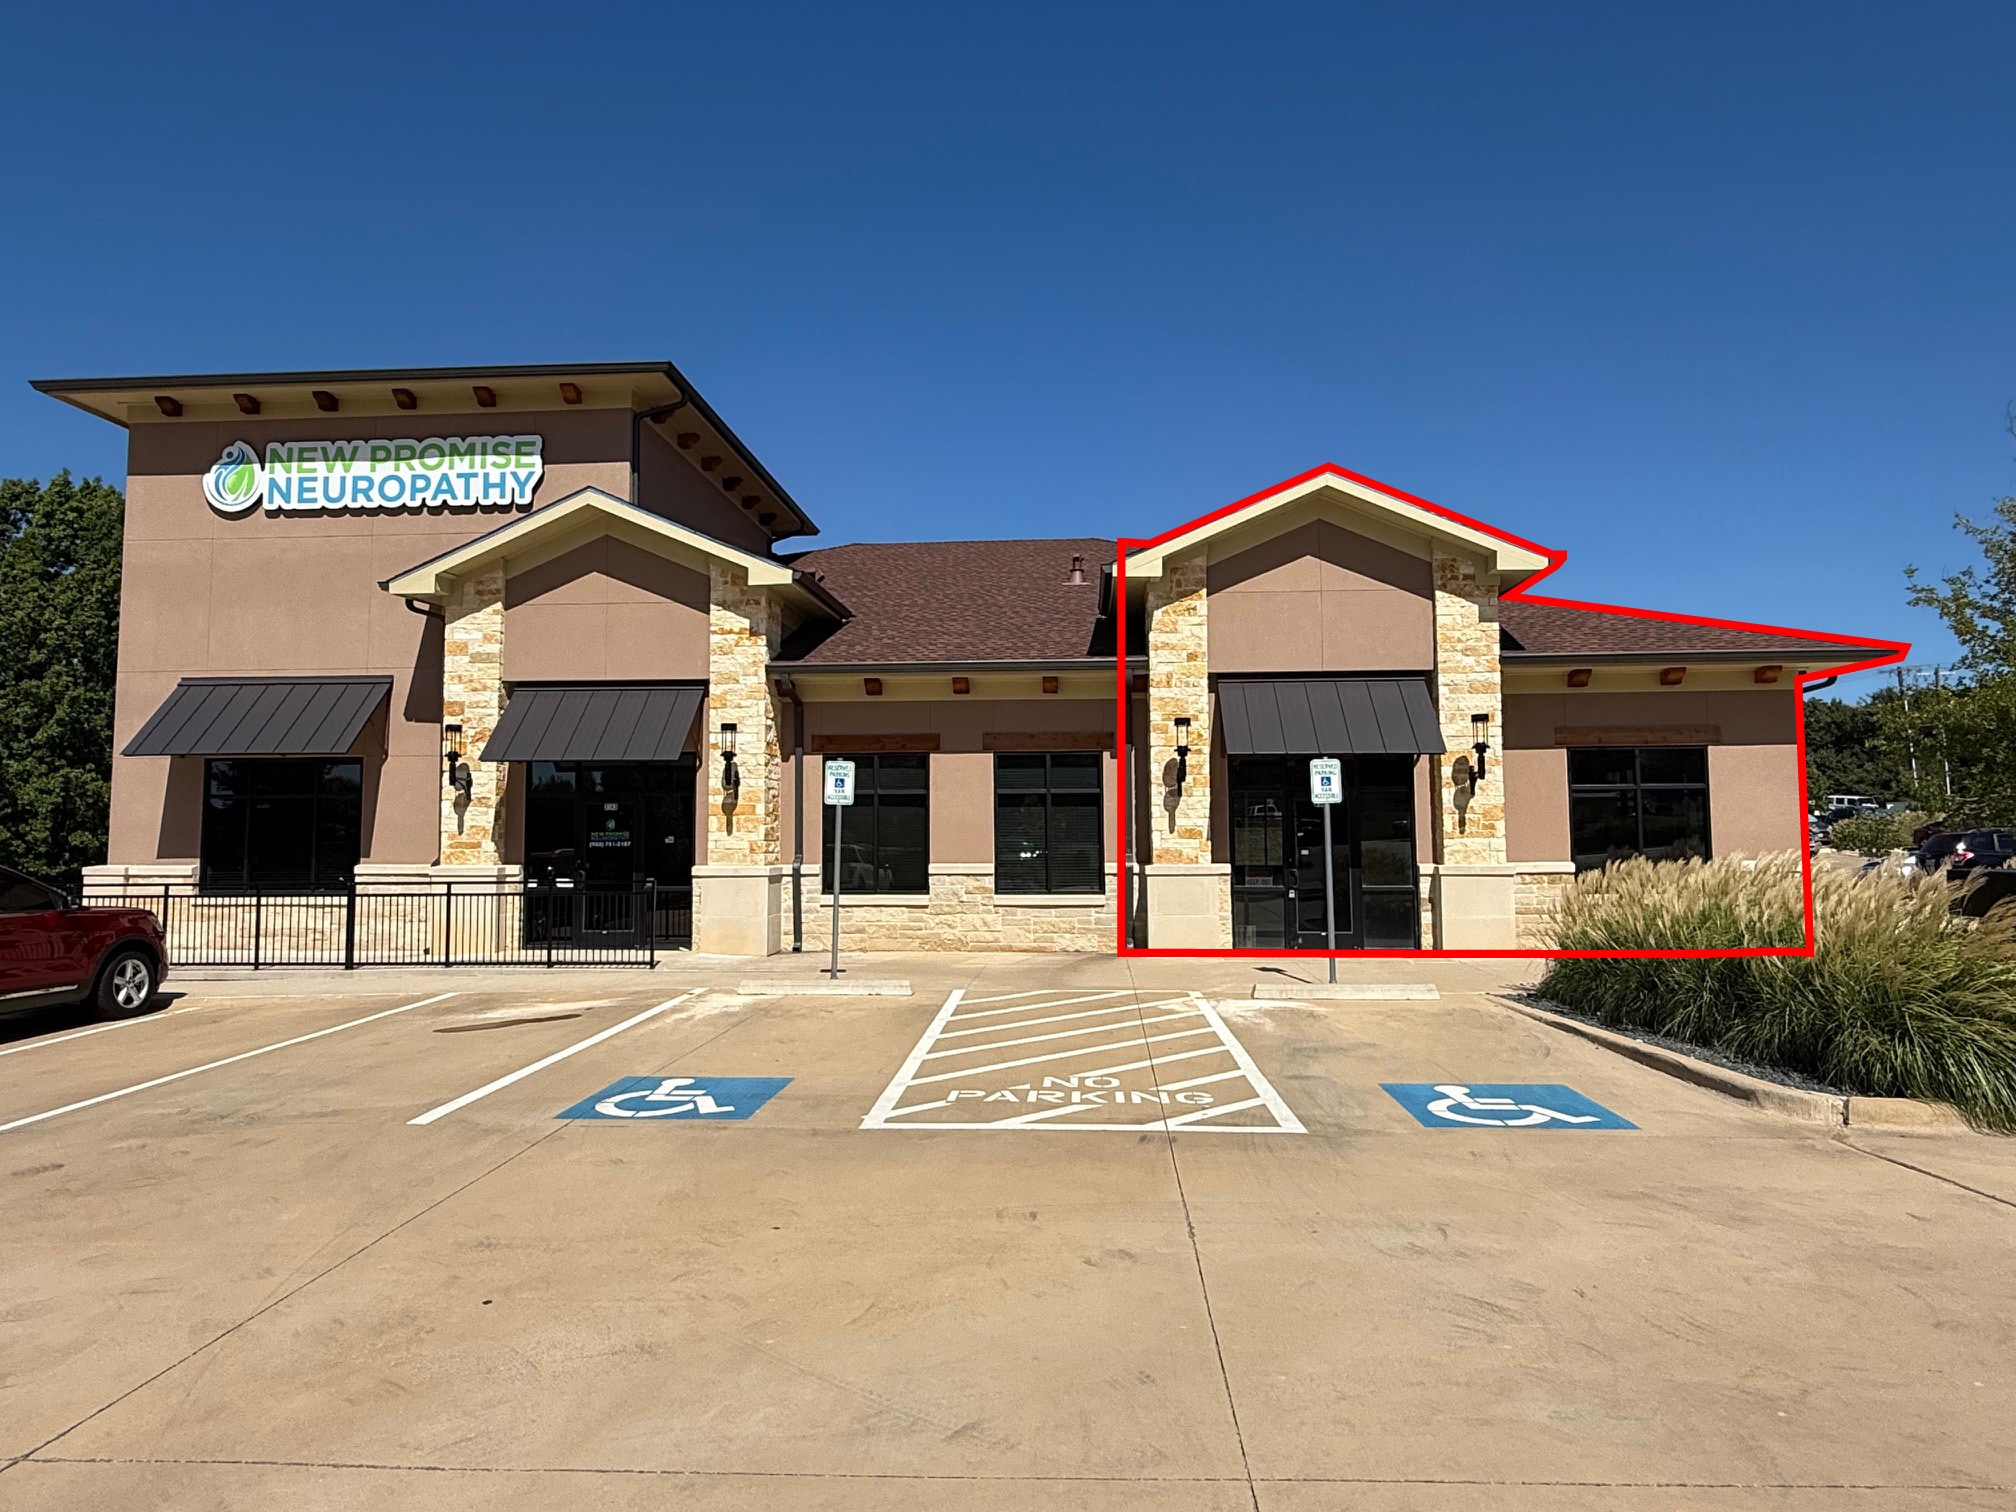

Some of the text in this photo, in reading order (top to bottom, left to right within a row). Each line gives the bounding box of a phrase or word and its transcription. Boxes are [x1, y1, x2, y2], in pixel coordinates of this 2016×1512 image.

[267, 440, 536, 474] NEW PROMISE
[267, 471, 536, 505] NEUROPATHY
[1042, 1075, 1121, 1088] NO
[945, 1089, 1215, 1104] PARKING
